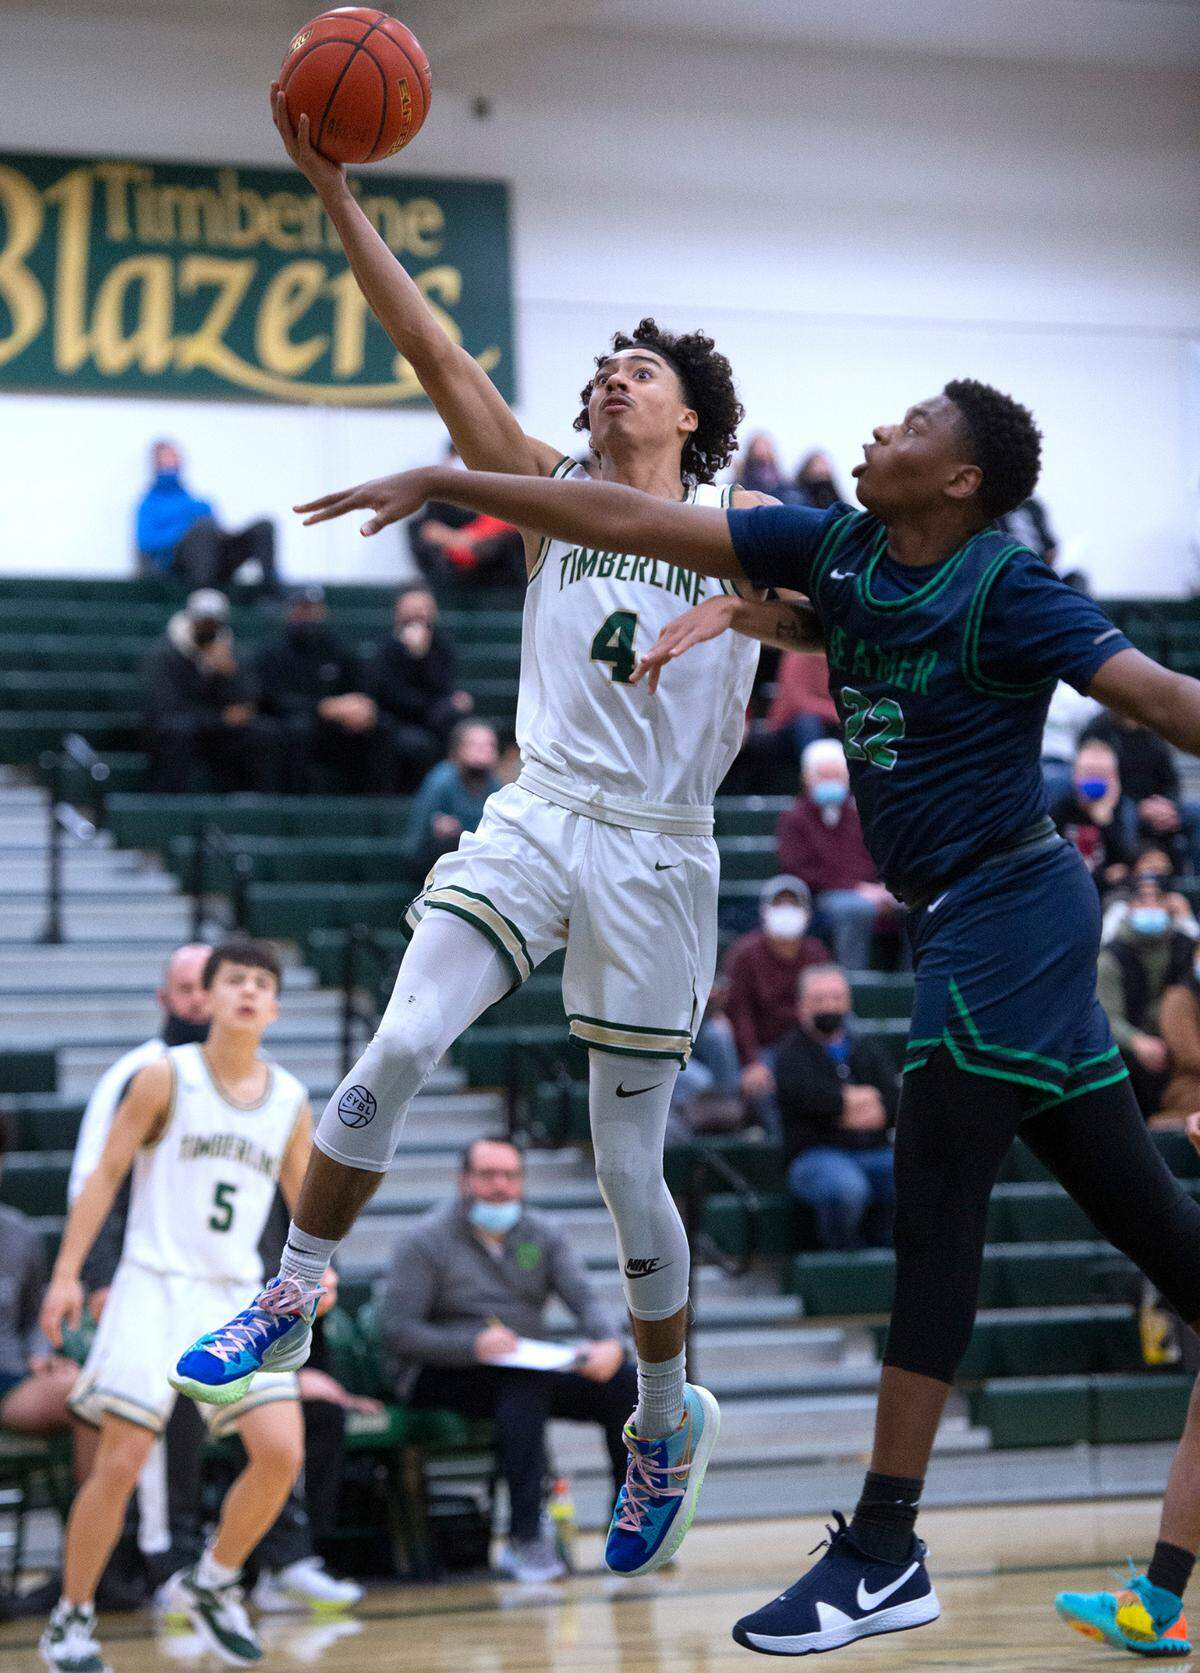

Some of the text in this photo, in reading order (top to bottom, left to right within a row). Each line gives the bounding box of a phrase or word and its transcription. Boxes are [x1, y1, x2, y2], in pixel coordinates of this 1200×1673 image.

[99, 162, 446, 258] Timberne
[589, 608, 640, 686] 4
[841, 686, 905, 770] 22
[346, 1093, 371, 1115] EYBL
[210, 1182, 237, 1232] 5
[626, 1257, 660, 1273] NIKE
